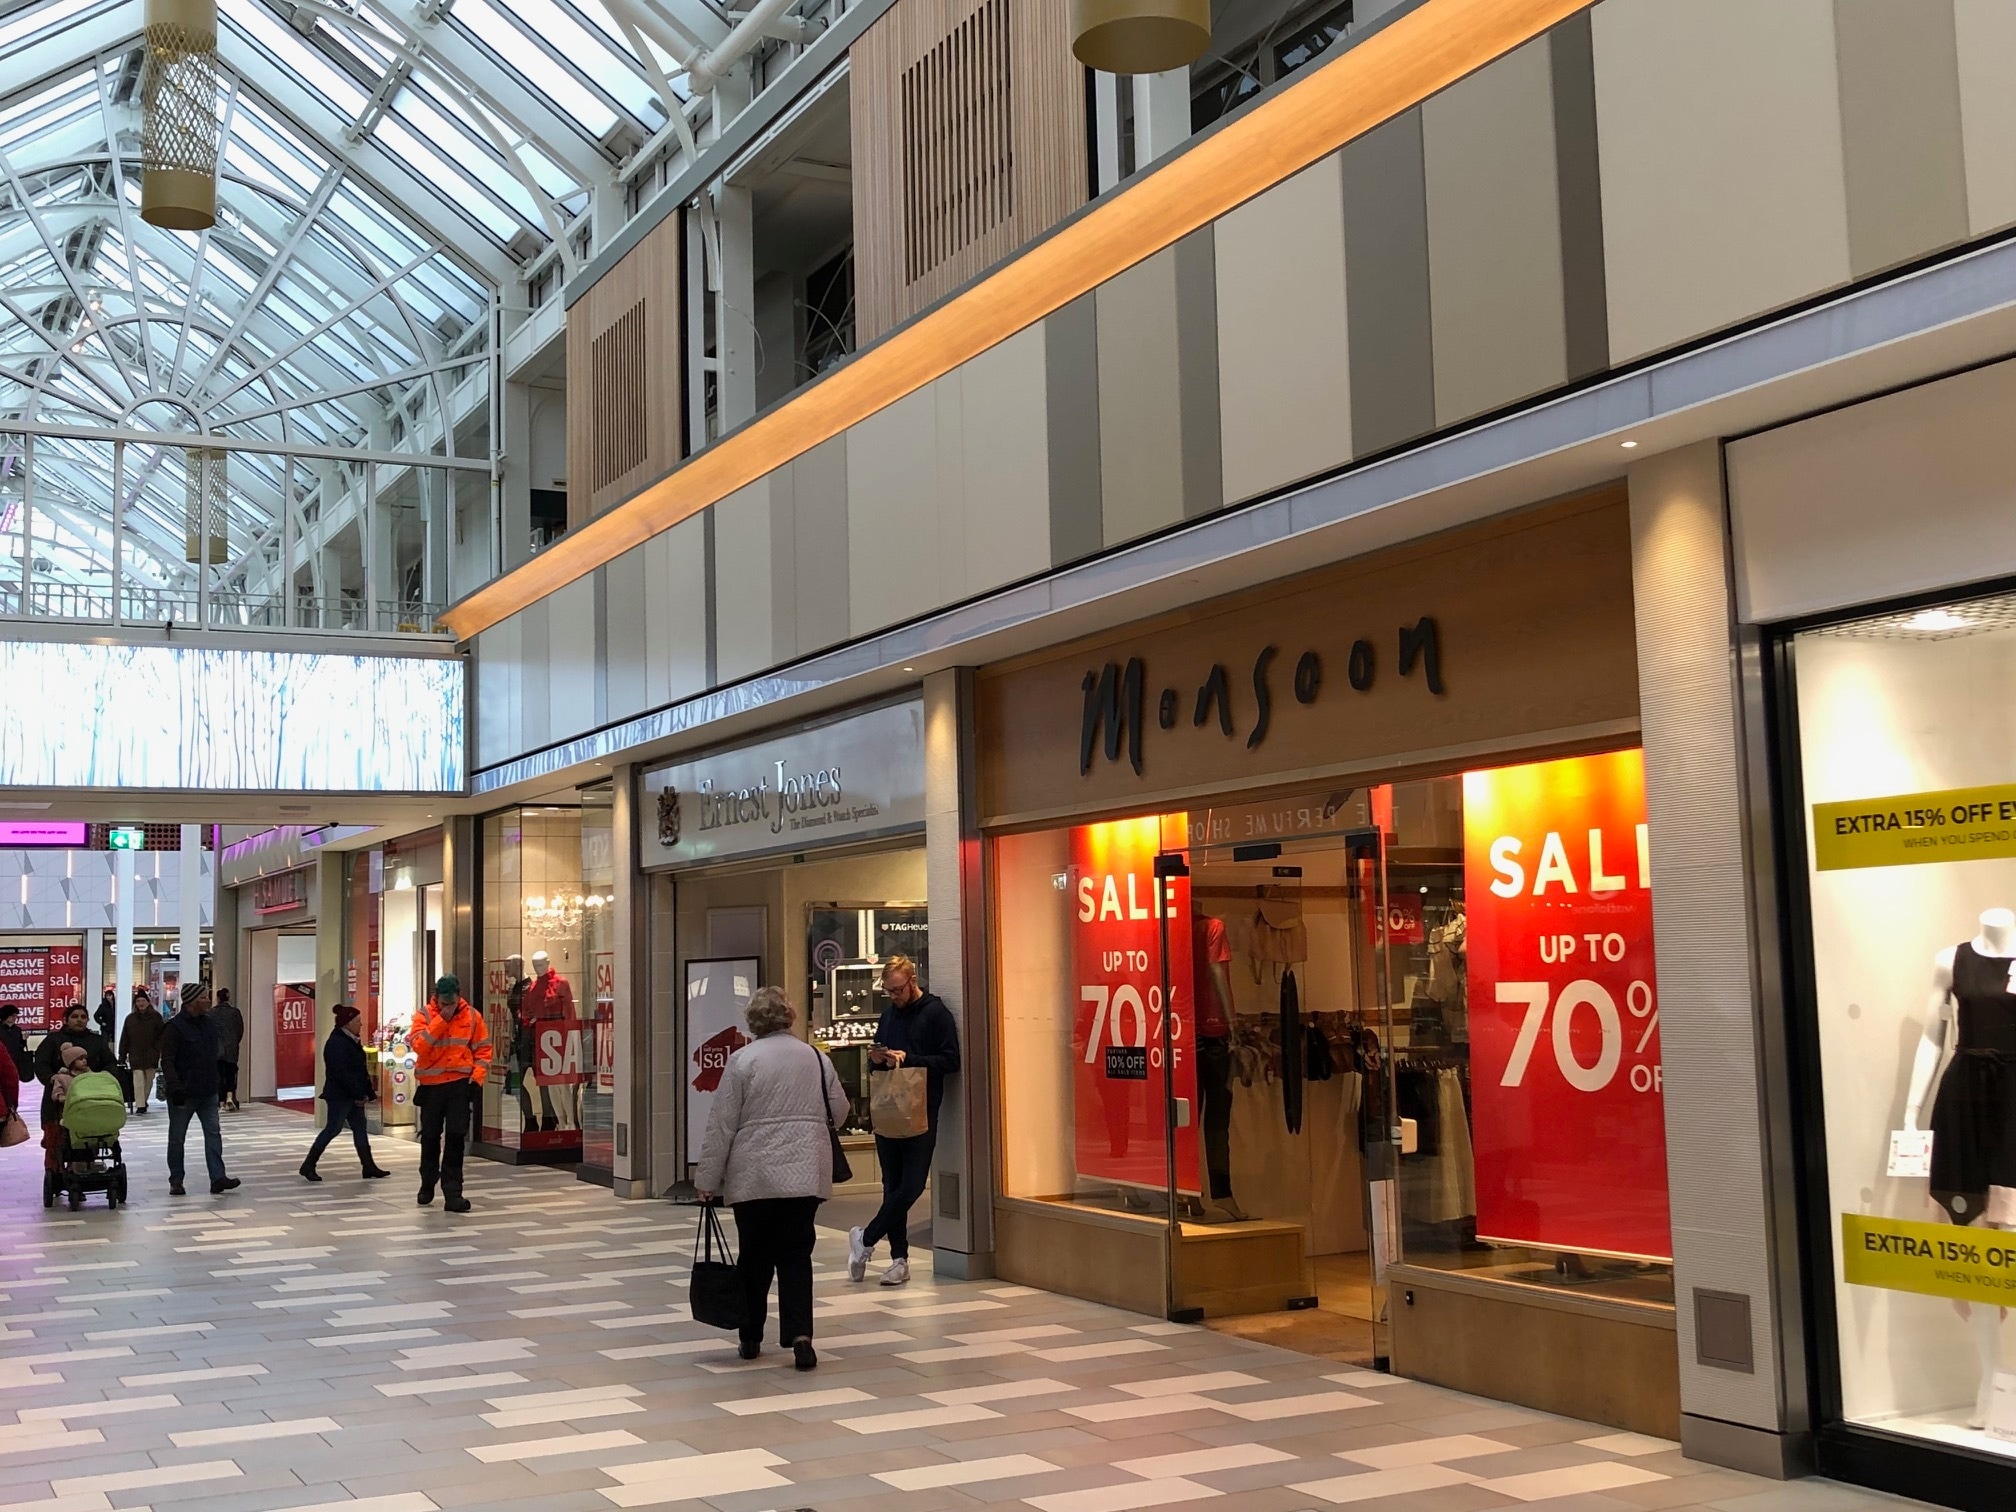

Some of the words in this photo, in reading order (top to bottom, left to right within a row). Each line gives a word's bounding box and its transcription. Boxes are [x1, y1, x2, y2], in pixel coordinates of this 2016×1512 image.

[1080, 616, 1445, 777] Monsoon
[699, 778, 769, 831] Ernest
[770, 759, 841, 834] Jones
[1835, 812, 1901, 835] EXTRA
[1904, 808, 1946, 828] 15%
[1951, 803, 1993, 824] OFF
[1902, 836, 1938, 848] WHEN
[1940, 834, 1966, 845] YOU
[1968, 830, 2010, 843] SPEND
[1078, 873, 1177, 923] SALE
[50, 951, 80, 964] sale
[1539, 935, 1576, 964] UP
[1583, 932, 1626, 962] TO
[1102, 951, 1123, 972] UP
[1126, 950, 1148, 972] TO
[50, 973, 79, 986] sale
[597, 965, 614, 993] SA
[50, 995, 79, 1008] sale
[283, 1020, 307, 1030] SALE
[1107, 1056, 1125, 1069] 10%
[1126, 1056, 1145, 1069] OFF
[1864, 1232, 1934, 1259] EXTRA
[1937, 1241, 1981, 1264] 15%
[1934, 1269, 1972, 1284] WHEN
[1973, 1275, 2001, 1288] YOU
